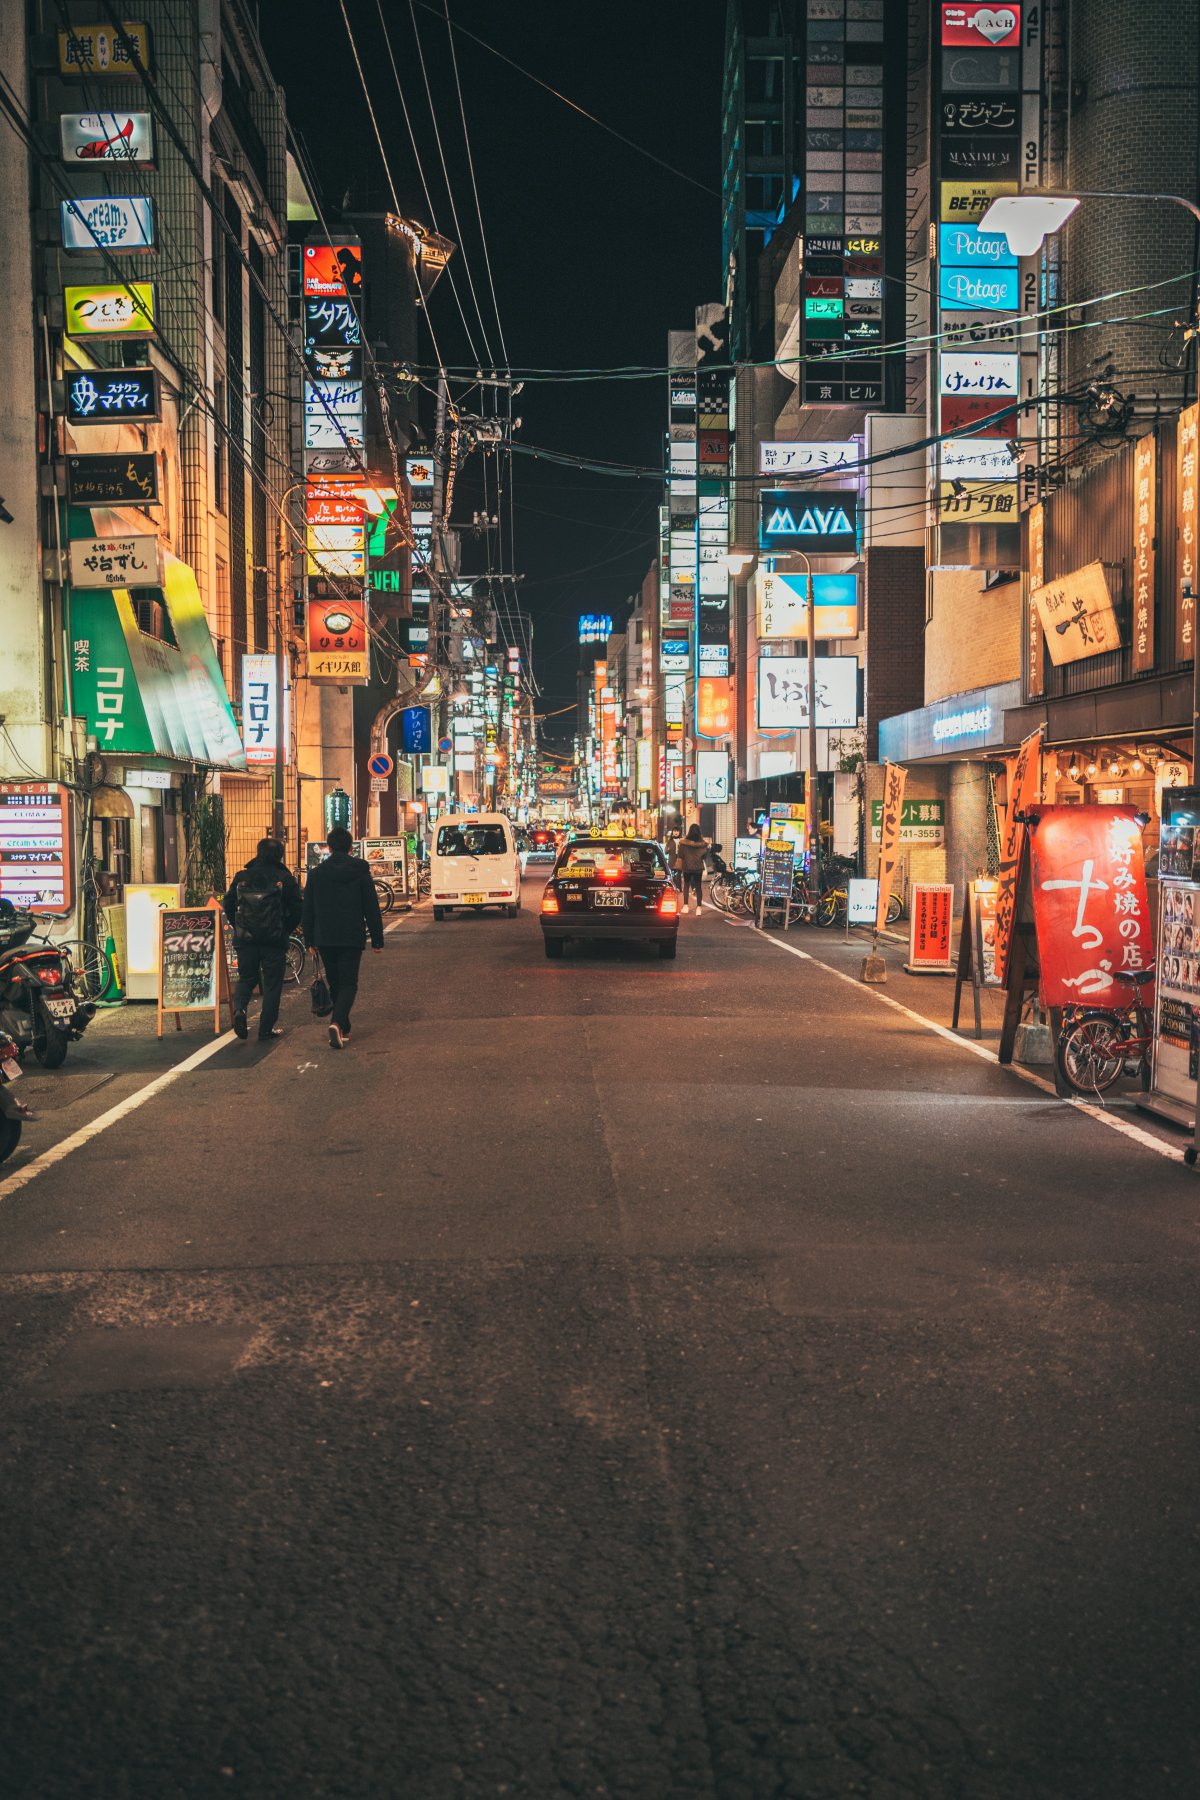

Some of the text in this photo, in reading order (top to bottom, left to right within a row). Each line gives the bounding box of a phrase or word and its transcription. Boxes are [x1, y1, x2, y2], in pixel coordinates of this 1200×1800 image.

[950, 153, 1010, 162] MAXIMUM
[808, 240, 841, 251] CARAVAN
[947, 231, 1008, 261] Potage
[947, 274, 1008, 304] Potage
[808, 302, 840, 313] 北尾
[99, 394, 149, 408] マイマイ
[820, 386, 876, 399] 京ビル
[943, 494, 1013, 513] カナダ館
[766, 507, 854, 534] MAYA
[83, 551, 144, 572] や台ずし
[74, 640, 90, 672] 喫茶
[316, 662, 361, 673] イギリス館
[95, 667, 125, 740] コロナ
[248, 682, 270, 743] コロナ
[875, 804, 941, 822] テント募集
[164, 933, 214, 953] マイマイ
